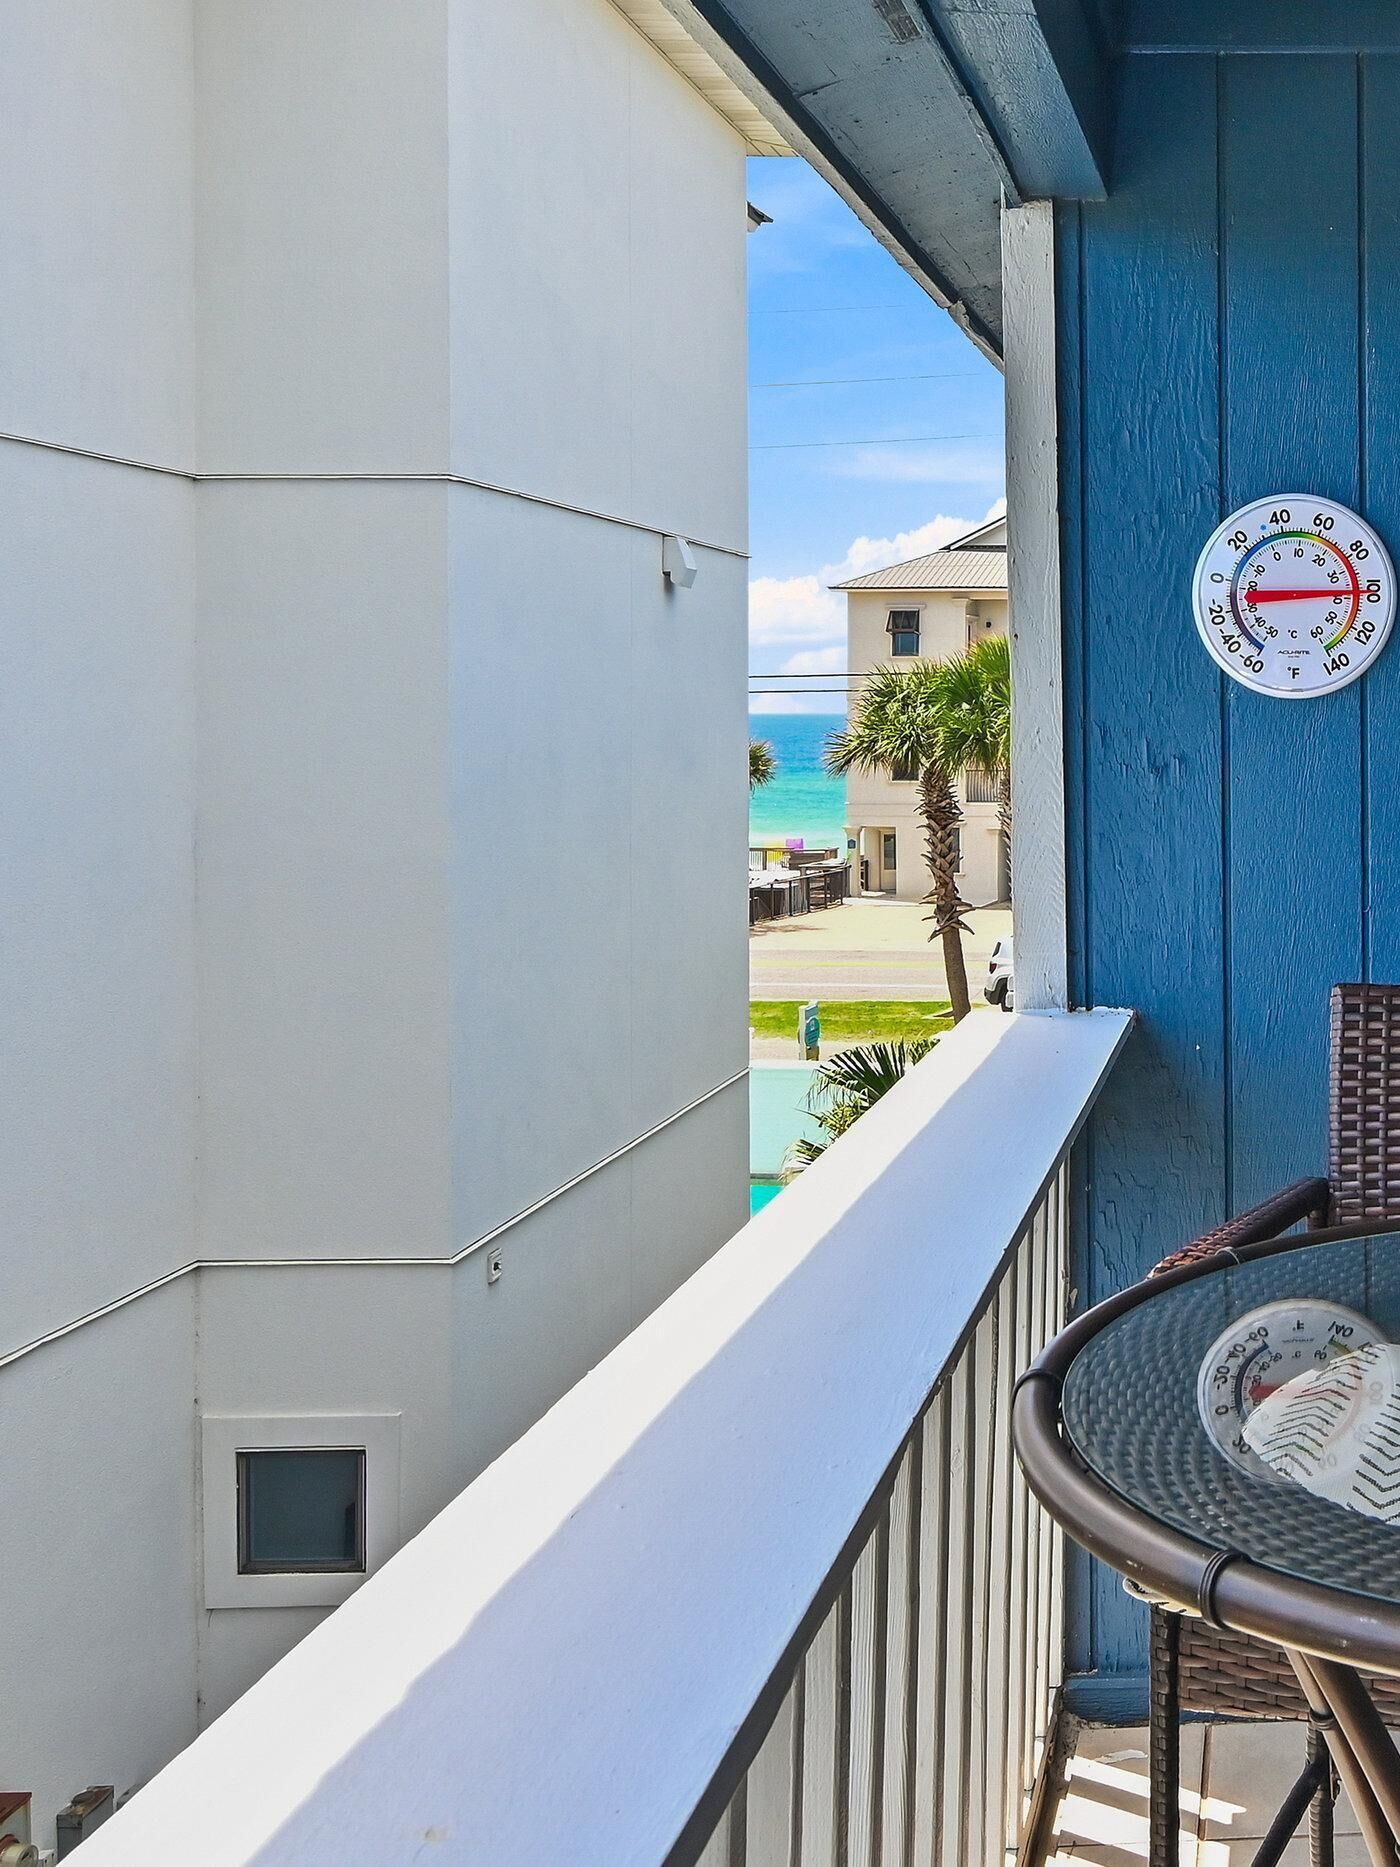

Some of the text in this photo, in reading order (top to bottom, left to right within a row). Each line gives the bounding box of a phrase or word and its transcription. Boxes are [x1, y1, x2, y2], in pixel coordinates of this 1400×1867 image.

[1269, 509, 1291, 525] 40
[1313, 513, 1334, 531] 60
[1227, 530, 1247, 551] 20
[1274, 552, 1281, 561] 0
[1294, 548, 1304, 557] 10
[1349, 540, 1369, 561] 80
[1312, 555, 1325, 567] 20
[1210, 573, 1224, 583] 0
[1254, 564, 1266, 578] -10
[1327, 570, 1339, 584] 30
[1367, 579, 1380, 603] 100
[1208, 599, 1225, 625] -20
[1325, 611, 1337, 625] 50
[1253, 614, 1266, 627] -40
[1264, 625, 1278, 638] -50
[1288, 630, 1297, 638] °C
[1310, 626, 1324, 638] 60
[1355, 621, 1375, 645] 120
[1219, 629, 1241, 653] -40
[1239, 653, 1264, 673] -60
[1323, 653, 1349, 676] 140
[1287, 667, 1299, 679] °F
